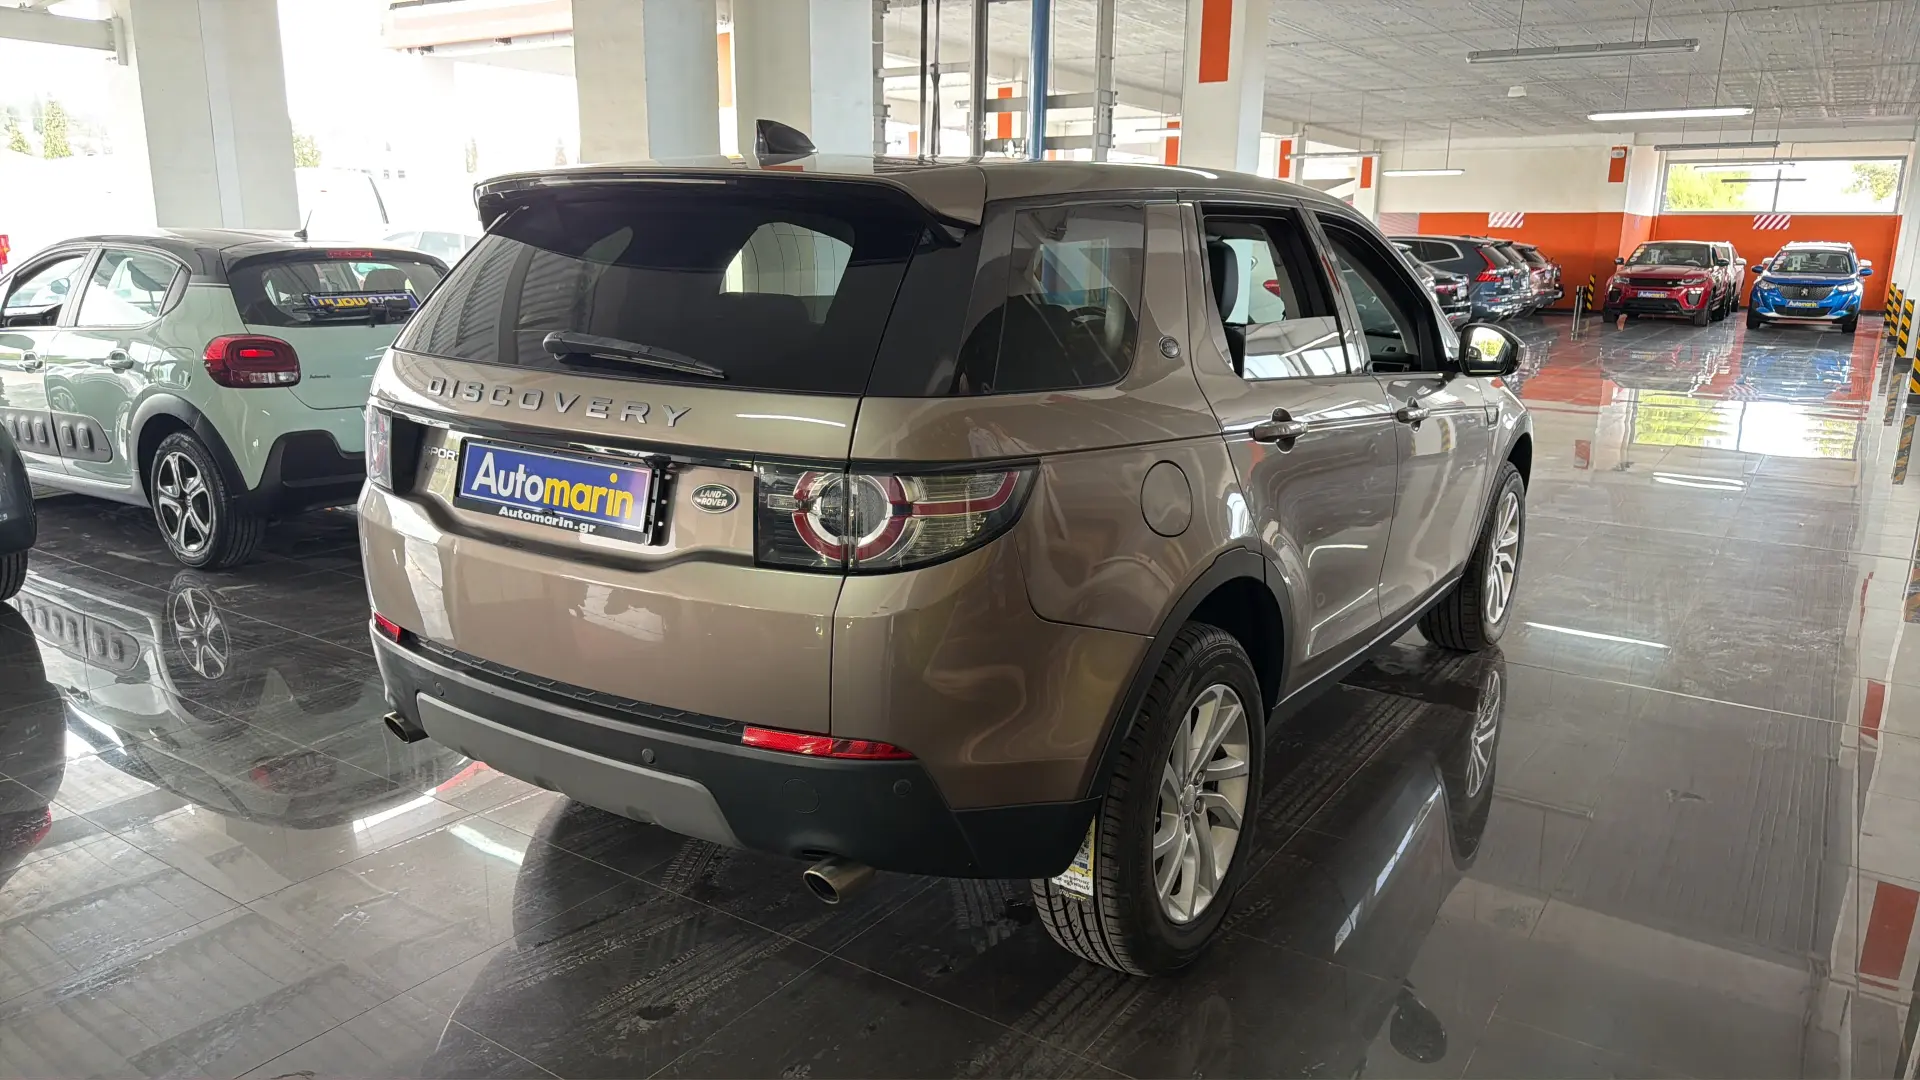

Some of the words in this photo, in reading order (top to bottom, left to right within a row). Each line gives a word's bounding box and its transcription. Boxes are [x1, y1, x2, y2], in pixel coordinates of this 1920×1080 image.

[427, 376, 692, 427] DISCOVERY
[471, 451, 634, 520] Automarin
[700, 490, 722, 499] LAND
[700, 497, 728, 507] ROVER
[498, 505, 597, 533] Automarin.gr
